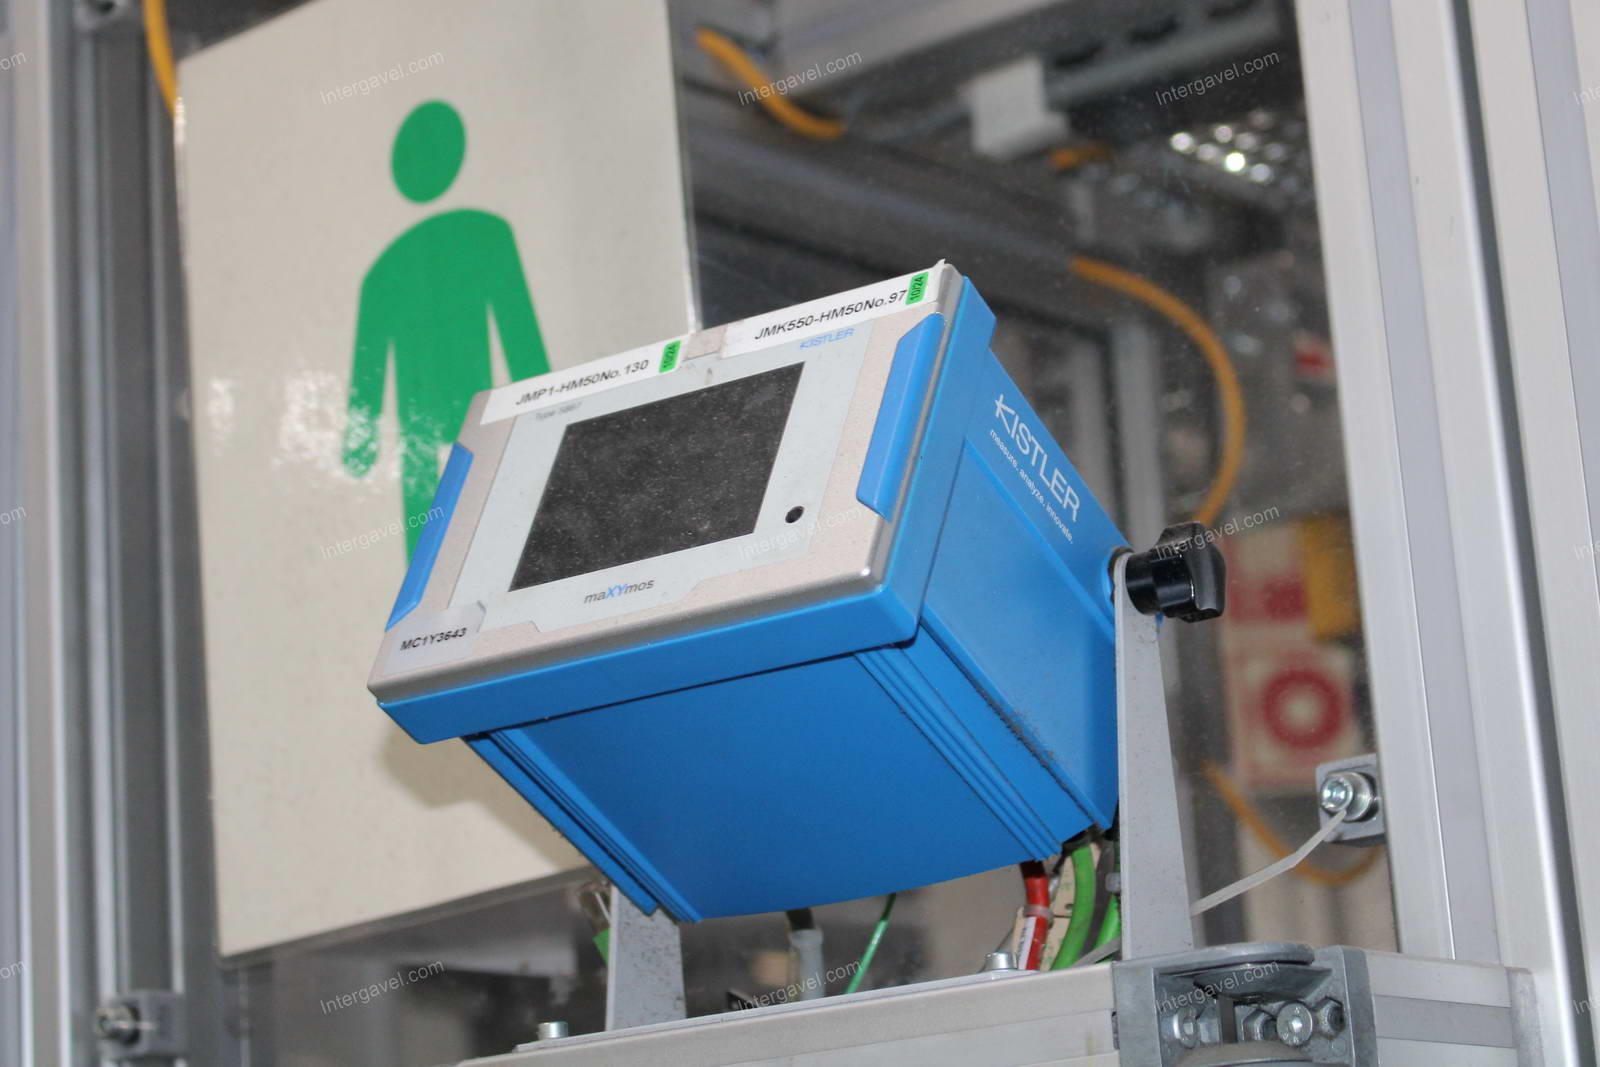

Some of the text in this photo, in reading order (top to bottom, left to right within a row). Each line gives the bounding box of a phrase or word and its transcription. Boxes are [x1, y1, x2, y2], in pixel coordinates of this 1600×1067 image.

[911, 276, 924, 300] 10/24
[755, 290, 907, 340] JMK550-HM50No.97
[800, 328, 854, 350] KISTLER
[995, 394, 1080, 523] KISTLER
[583, 579, 655, 604] maXYmos
[401, 627, 467, 650] MC1Y3643
